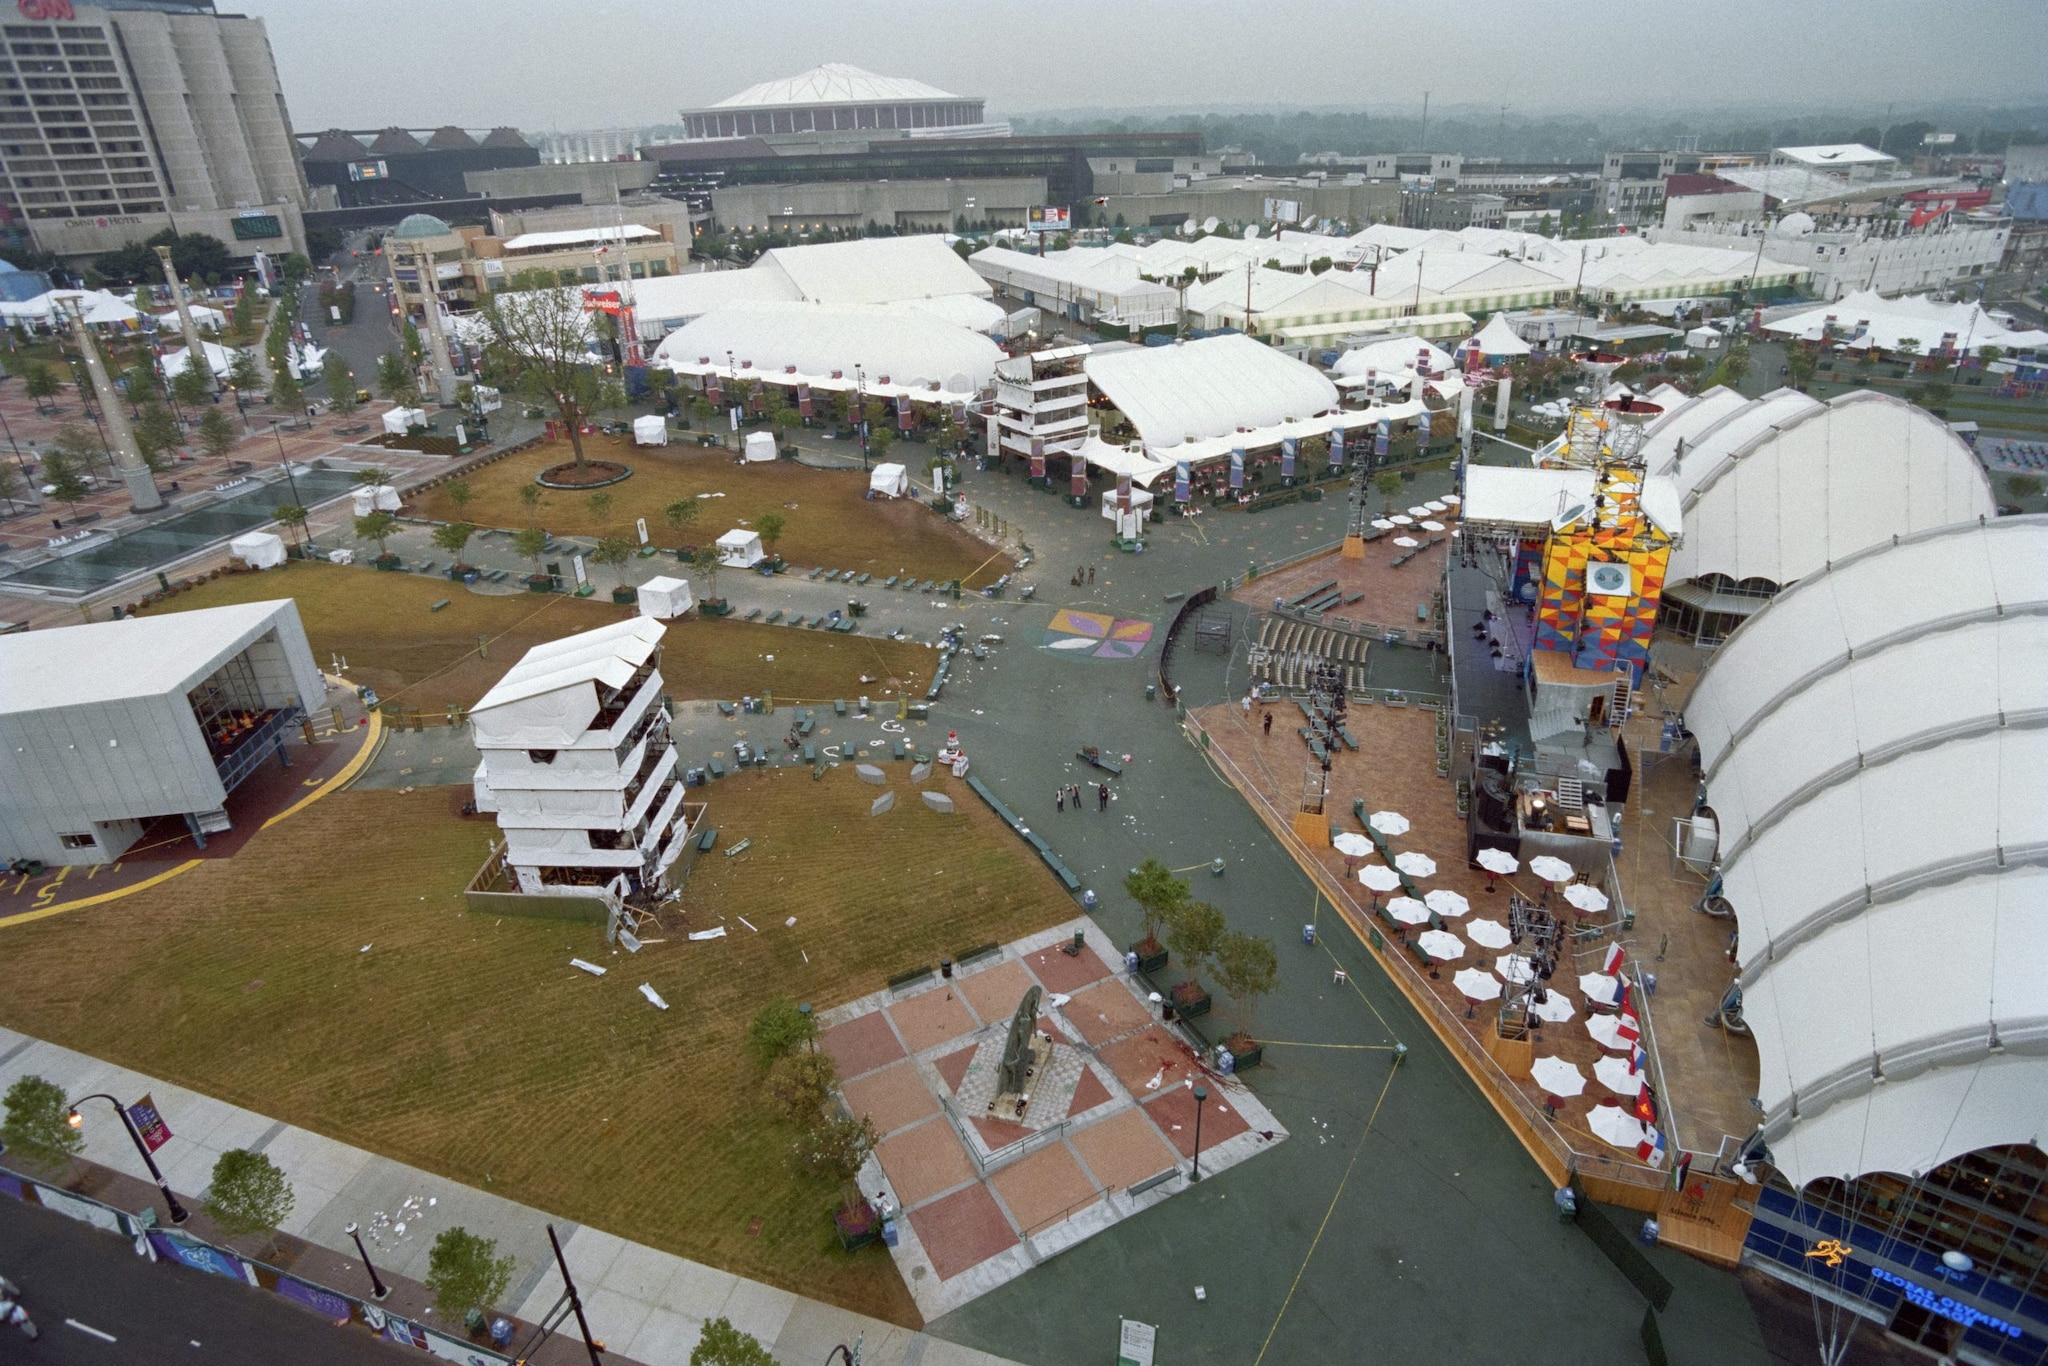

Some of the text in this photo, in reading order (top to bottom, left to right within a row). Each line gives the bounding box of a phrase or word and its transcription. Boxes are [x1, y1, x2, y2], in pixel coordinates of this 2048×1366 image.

[1934, 1265, 1968, 1282] AT&T
[1871, 1267, 2022, 1338] GLOBAL OLYMPIC
[1905, 1290, 1975, 1327] VILLAGE
